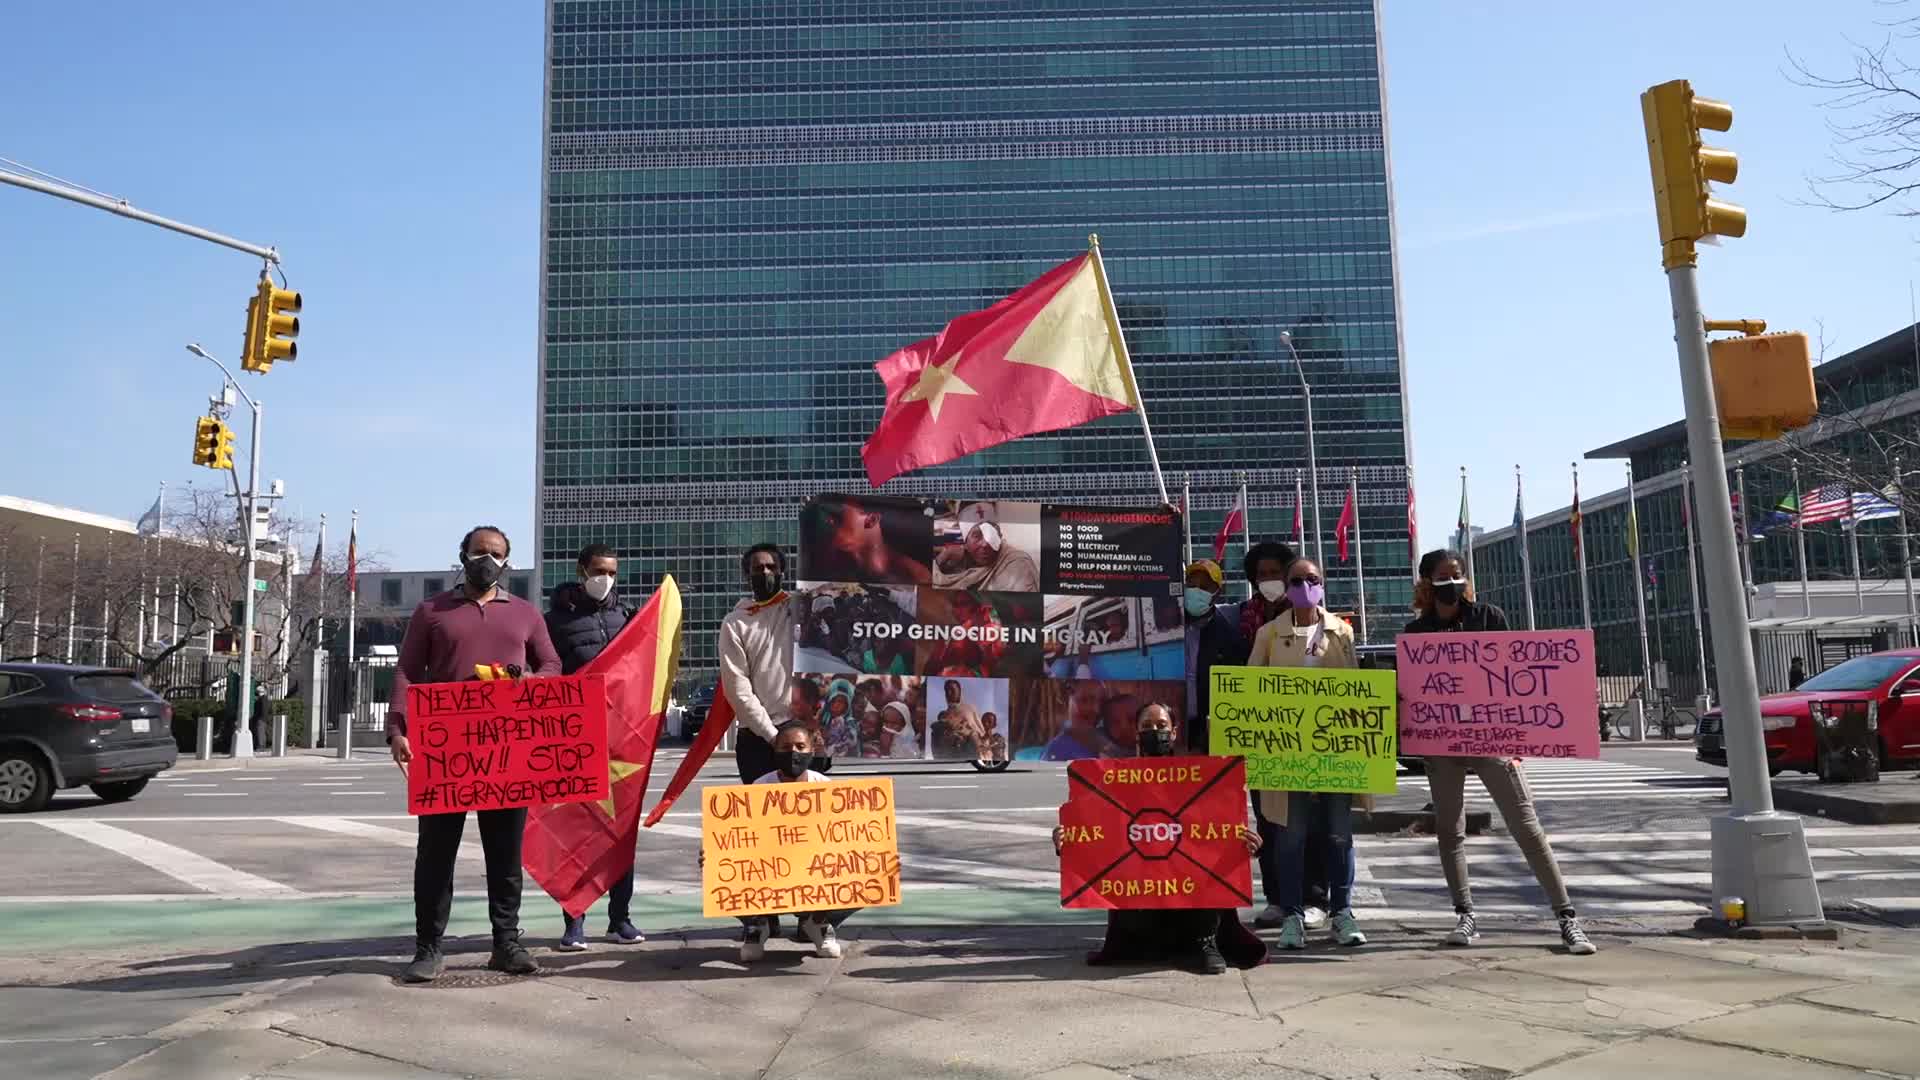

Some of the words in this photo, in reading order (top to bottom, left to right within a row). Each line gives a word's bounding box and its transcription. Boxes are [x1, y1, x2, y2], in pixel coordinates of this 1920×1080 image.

[1078, 543, 1120, 551] ELECTRICITY
[1078, 552, 1137, 561] HUMANITARIAN
[1112, 564, 1131, 572] RAPE
[852, 622, 902, 639] STOP
[908, 624, 1009, 643] GENOCIDE
[1015, 626, 1036, 643] IN
[1041, 629, 1111, 645] TIGRAY
[1403, 640, 1498, 664] WOMEN'S
[1508, 638, 1580, 663] BODIES
[1212, 672, 1245, 693] THE
[1259, 673, 1381, 698] INTERNATIONAL
[1421, 672, 1464, 694] ARE
[1480, 665, 1559, 697] NOT
[414, 682, 496, 715] NEVER
[513, 680, 584, 708] AGAIN
[1214, 702, 1304, 728] COMMUNITY
[1314, 704, 1390, 729] CANNOT
[1410, 701, 1564, 728] BATTLEFIELDS
[420, 721, 448, 747] IS
[462, 713, 583, 745] HAPPENING
[1224, 726, 1302, 753] REMAIN
[423, 745, 510, 778] NOW!!
[527, 743, 594, 772] STOP
[1448, 740, 1577, 757] #TIGRAYGENOCIDE
[1103, 765, 1202, 784] GENOCIDE
[1248, 772, 1368, 789] #TIGRAYGENOCIDE
[416, 775, 599, 808] #TIGRAYGENOCIDE
[710, 791, 752, 820] UN
[762, 788, 826, 816] MUST
[831, 786, 888, 814] STAND
[712, 826, 759, 850] WITH
[770, 825, 808, 845] THE
[817, 816, 891, 844] VICTIMS!
[1064, 824, 1105, 841] WAR
[1129, 823, 1183, 842] STOP
[1190, 823, 1247, 839] RAPE
[718, 856, 791, 882] STAND
[806, 850, 892, 879] AGAINST
[711, 875, 897, 911] PERPETRATORS!!
[1101, 877, 1195, 896] BOMBING
